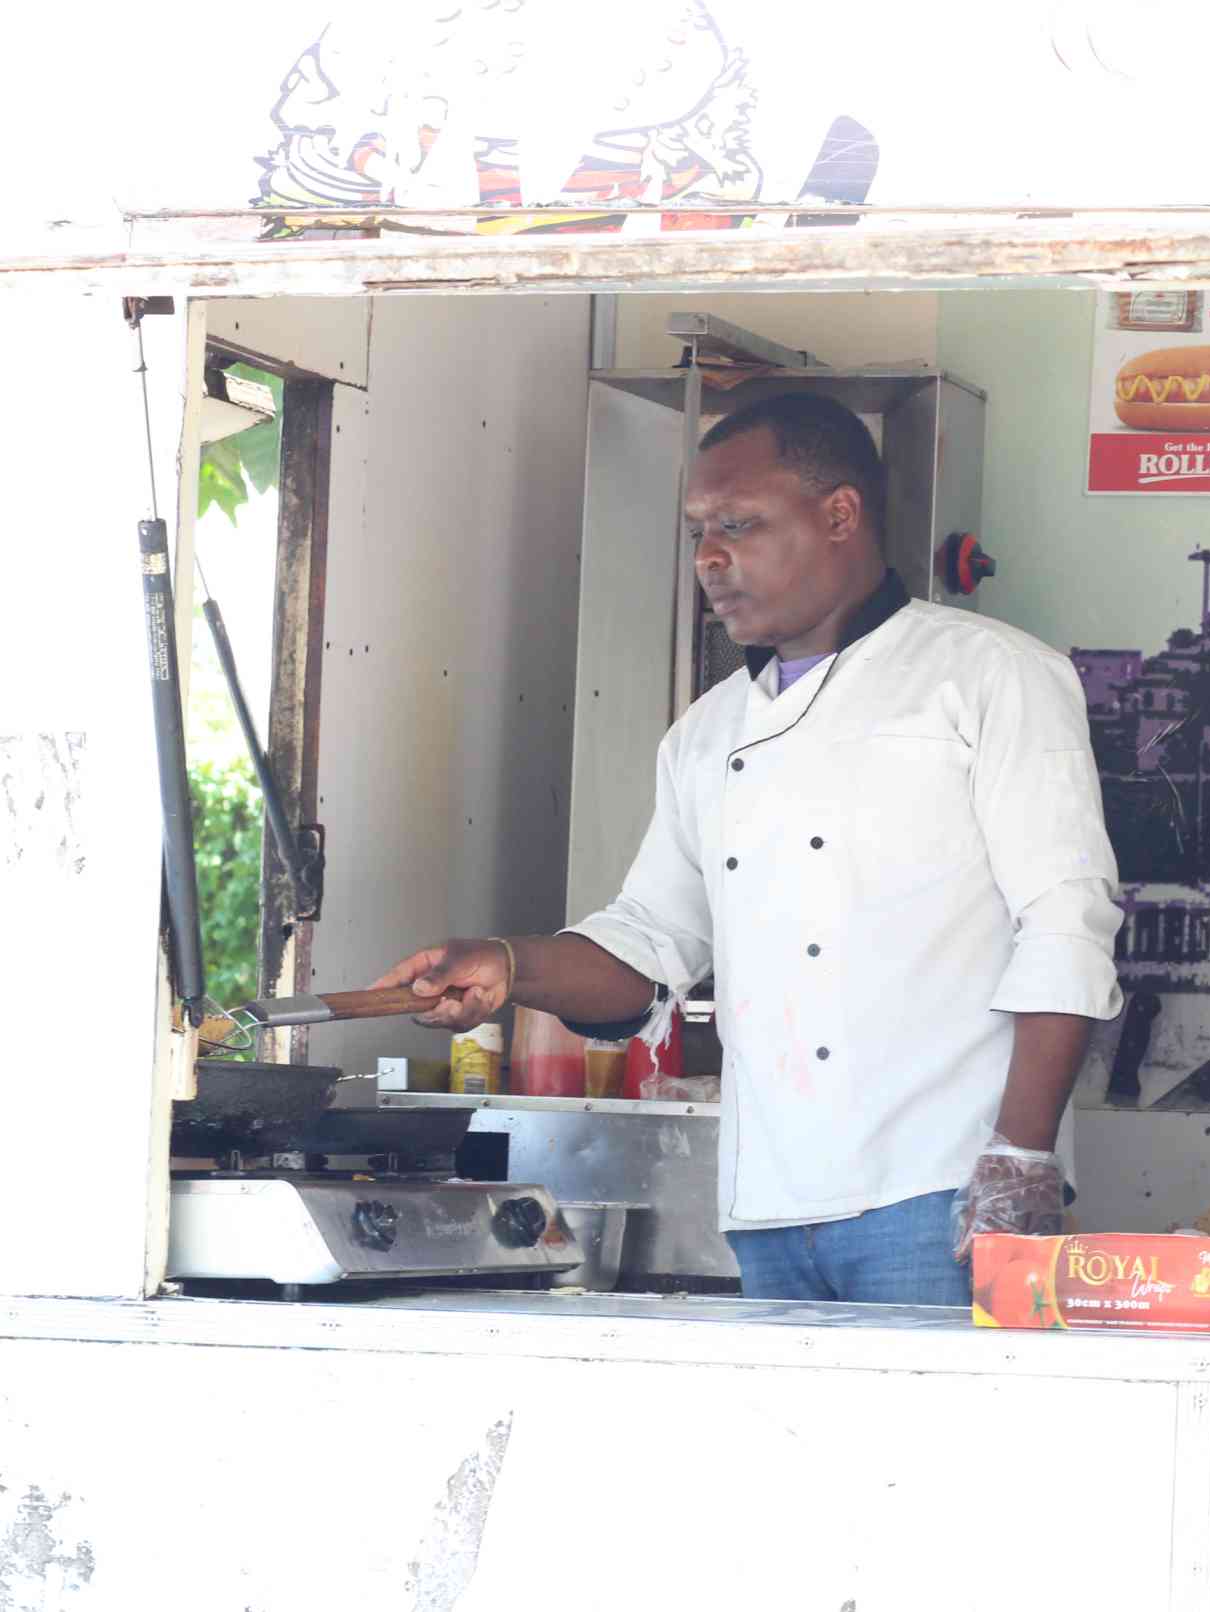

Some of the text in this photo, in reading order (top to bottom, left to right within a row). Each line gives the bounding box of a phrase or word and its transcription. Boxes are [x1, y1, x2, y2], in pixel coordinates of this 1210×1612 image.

[1164, 442, 1183, 452] Get
[1186, 442, 1203, 452] the
[1067, 1251, 1161, 1285] ROYAL
[1066, 1298, 1100, 1309] 30cm
[1115, 1300, 1150, 1310] 300m
